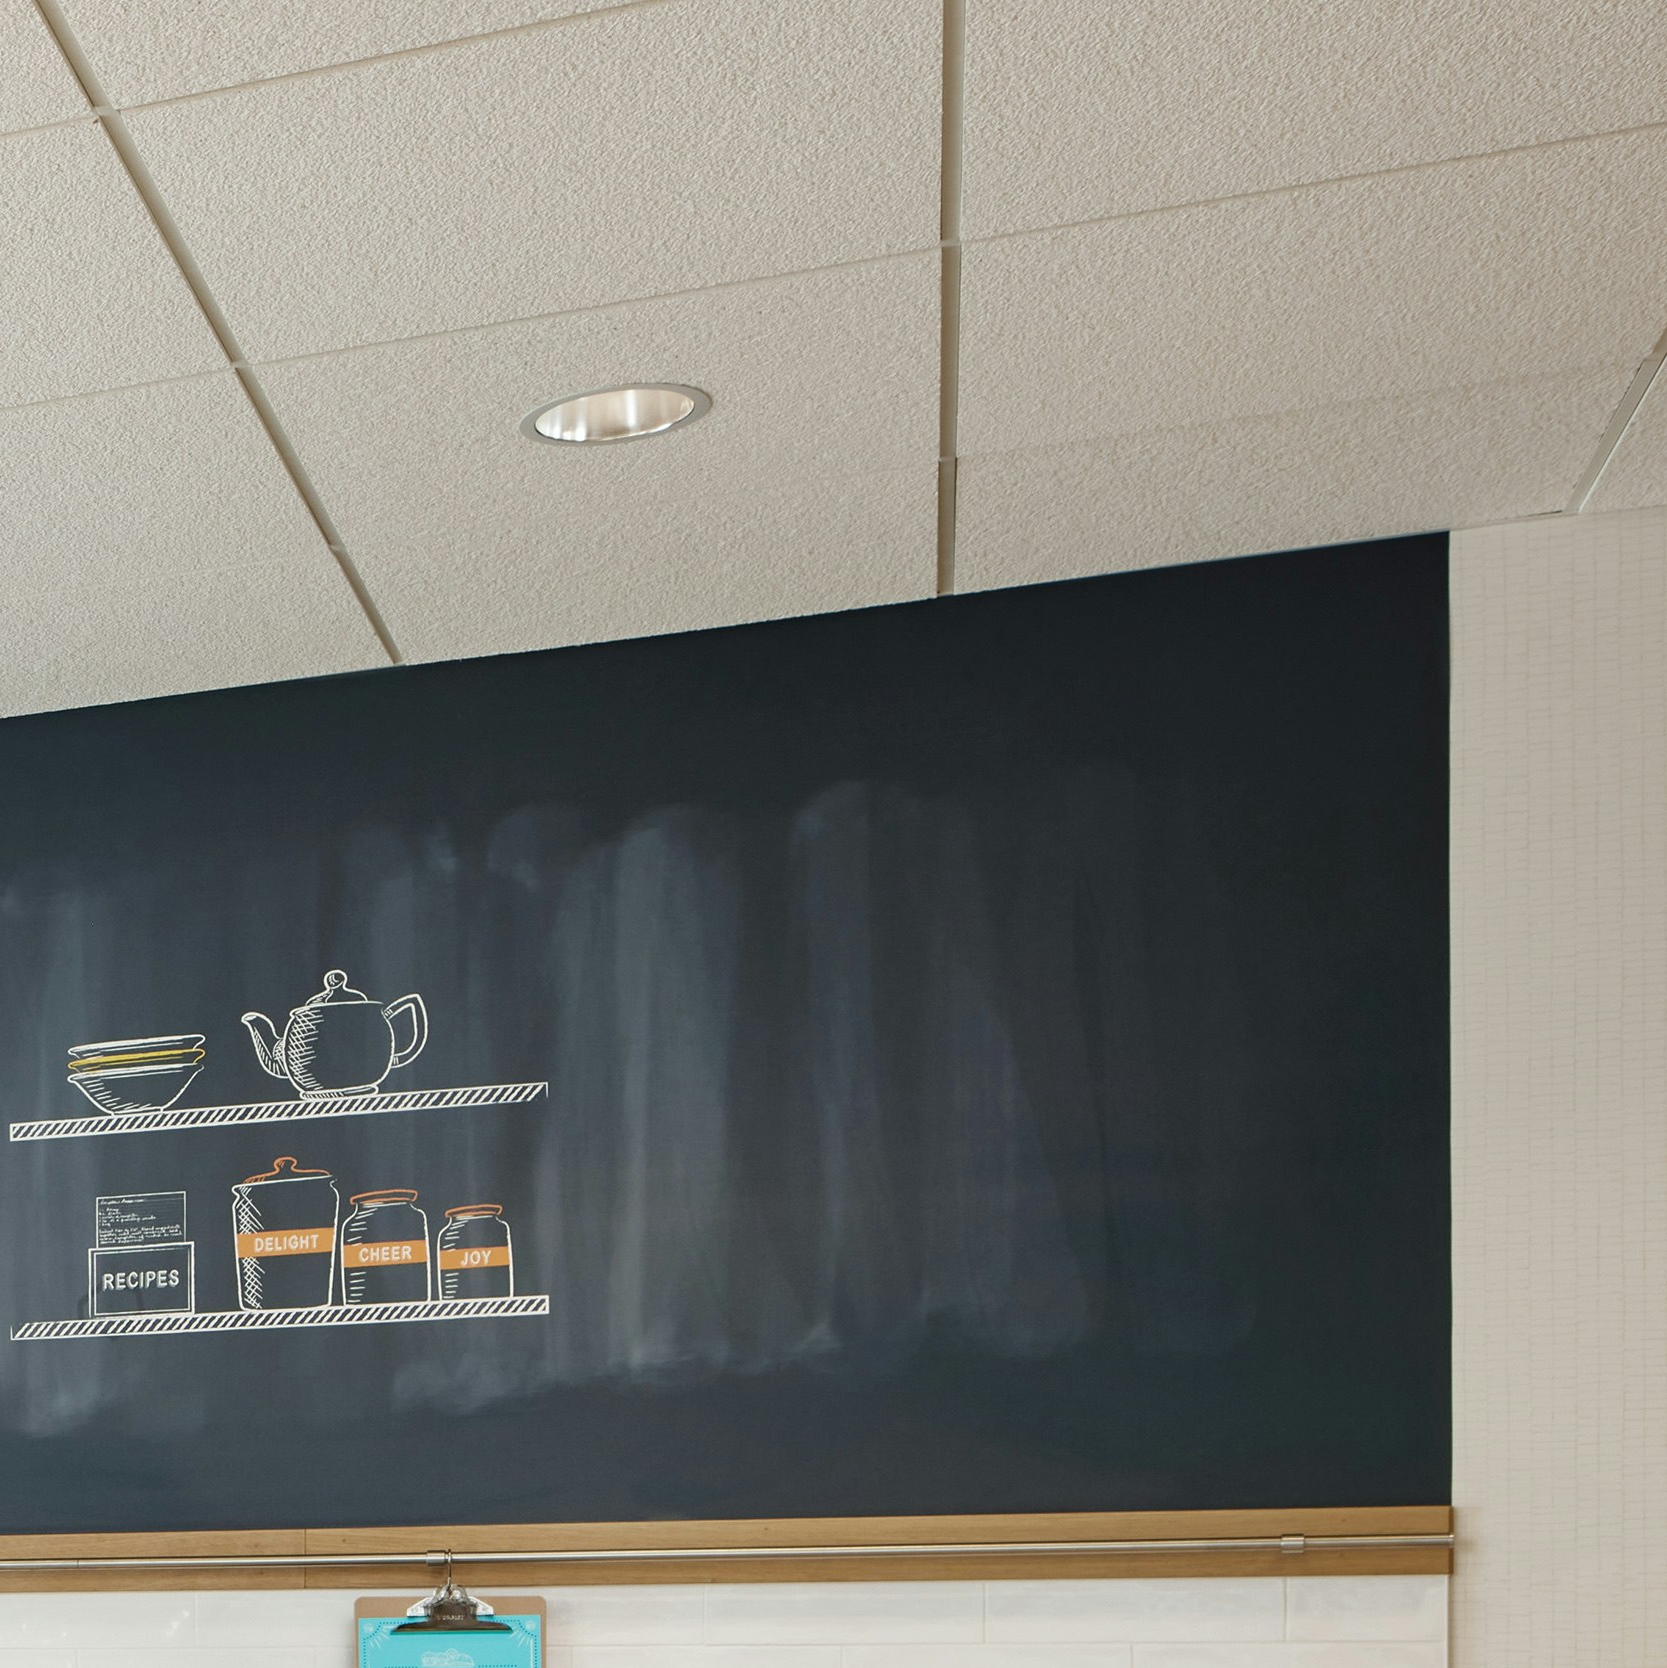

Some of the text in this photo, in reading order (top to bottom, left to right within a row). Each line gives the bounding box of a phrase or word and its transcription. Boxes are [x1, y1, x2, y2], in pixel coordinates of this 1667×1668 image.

[254, 1234, 319, 1252] DELIGHT
[358, 1246, 412, 1262] CHEER
[460, 1250, 492, 1266] JOY
[102, 1269, 180, 1292] RECIPES
